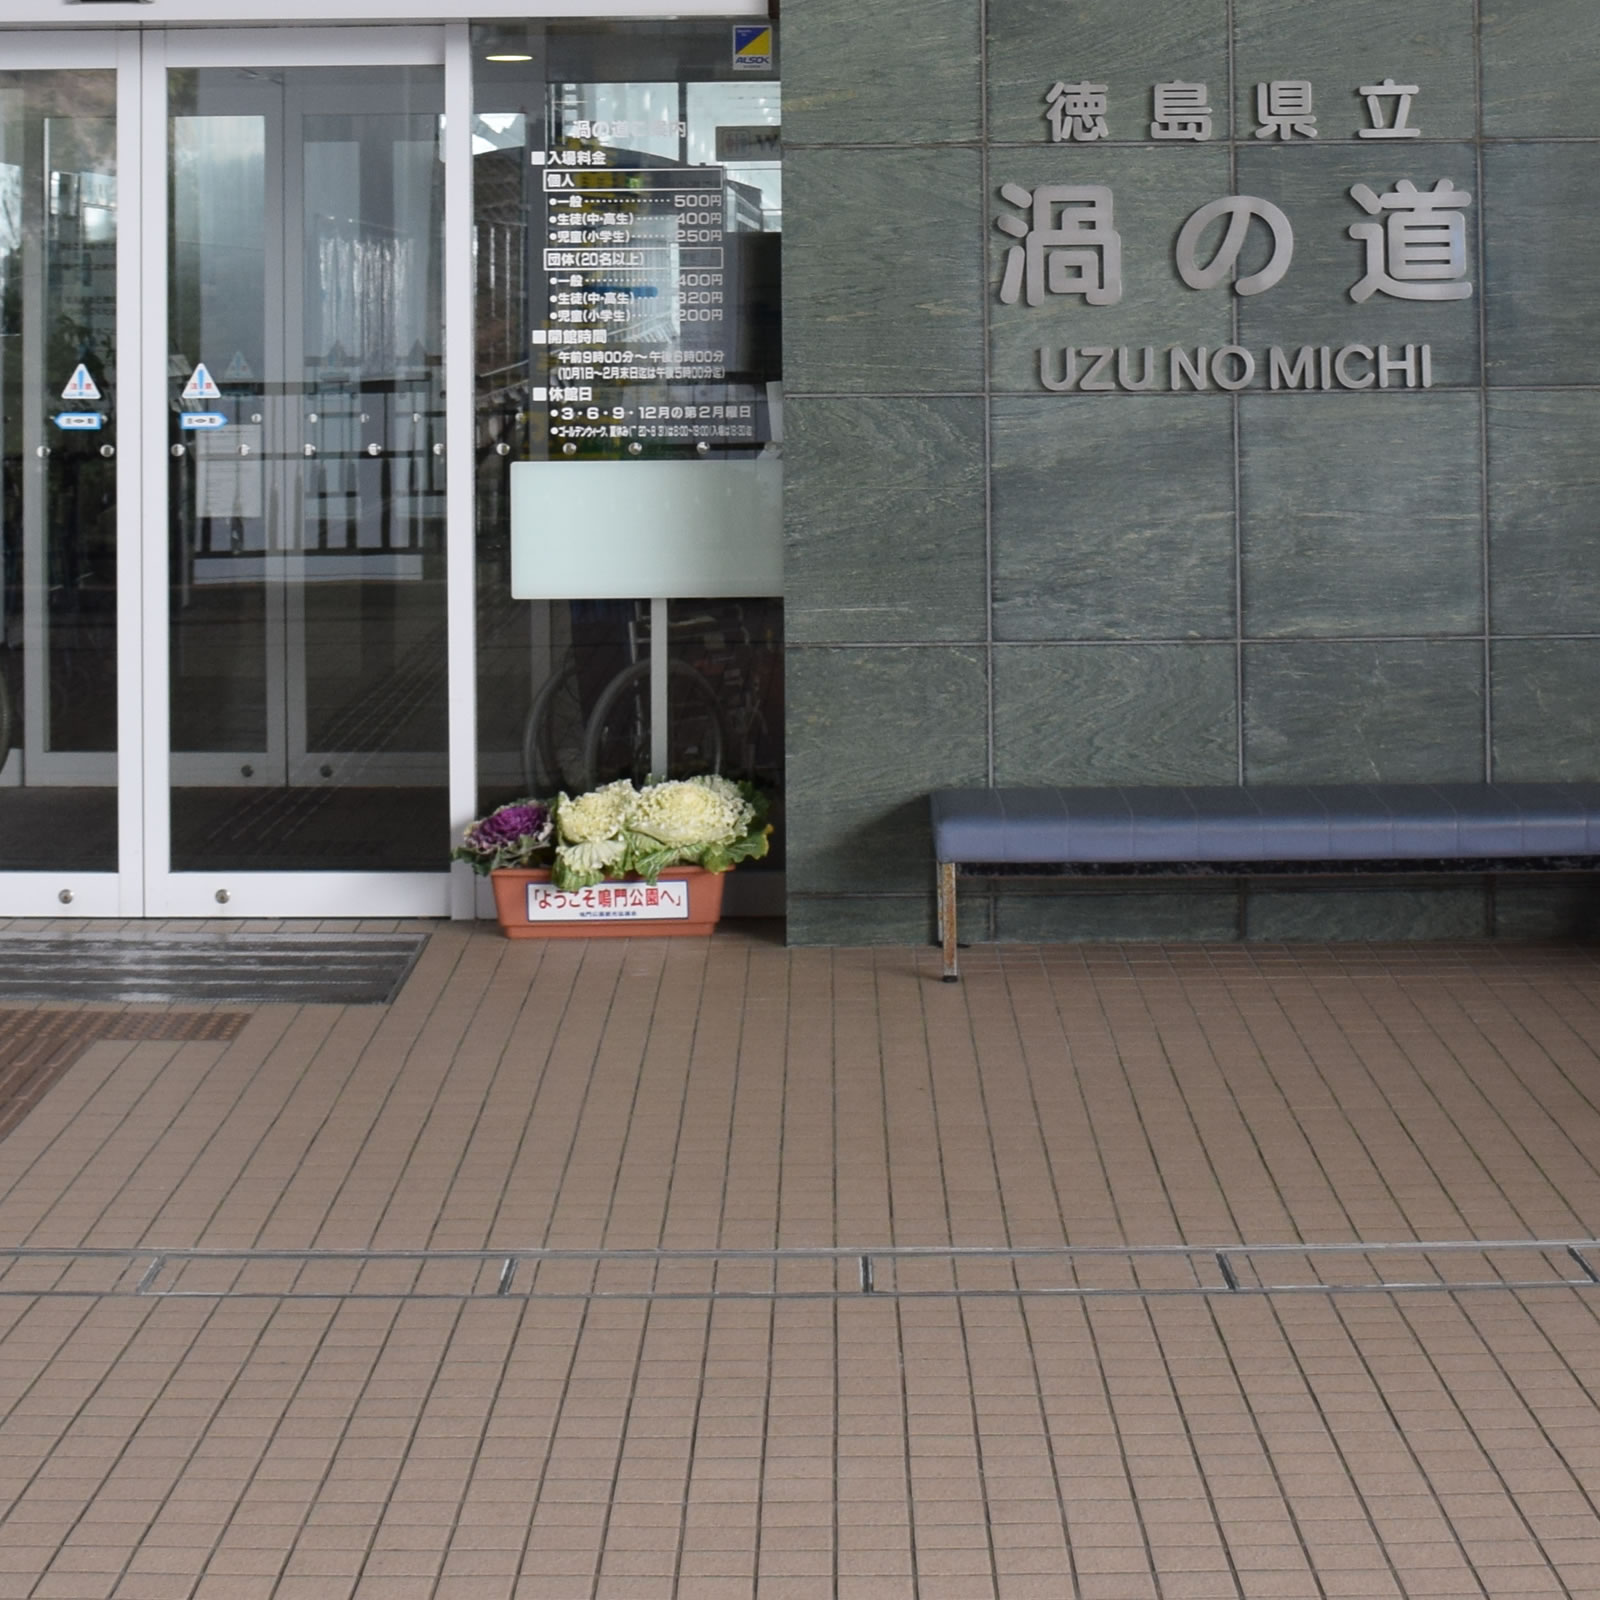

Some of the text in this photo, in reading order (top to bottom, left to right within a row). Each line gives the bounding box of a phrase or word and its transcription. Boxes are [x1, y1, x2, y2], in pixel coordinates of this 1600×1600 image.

[735, 56, 769, 64] ALSOK
[1045, 78, 1421, 142] 徳島県立
[548, 151, 607, 166] 入場料金
[547, 174, 575, 187] 個人
[557, 195, 722, 208] 一般 500円
[676, 212, 722, 225] 400円
[557, 230, 722, 243] 児童(小学生) 250円
[996, 178, 1473, 306] 渦の道
[547, 252, 644, 267] 団体(20名以上)
[557, 273, 723, 287] 一般 400円
[557, 309, 630, 322] 児童(小学生)
[548, 329, 607, 344] 開館時間
[1039, 343, 1432, 391] UZU NO MICHI
[549, 387, 593, 402] 休館日
